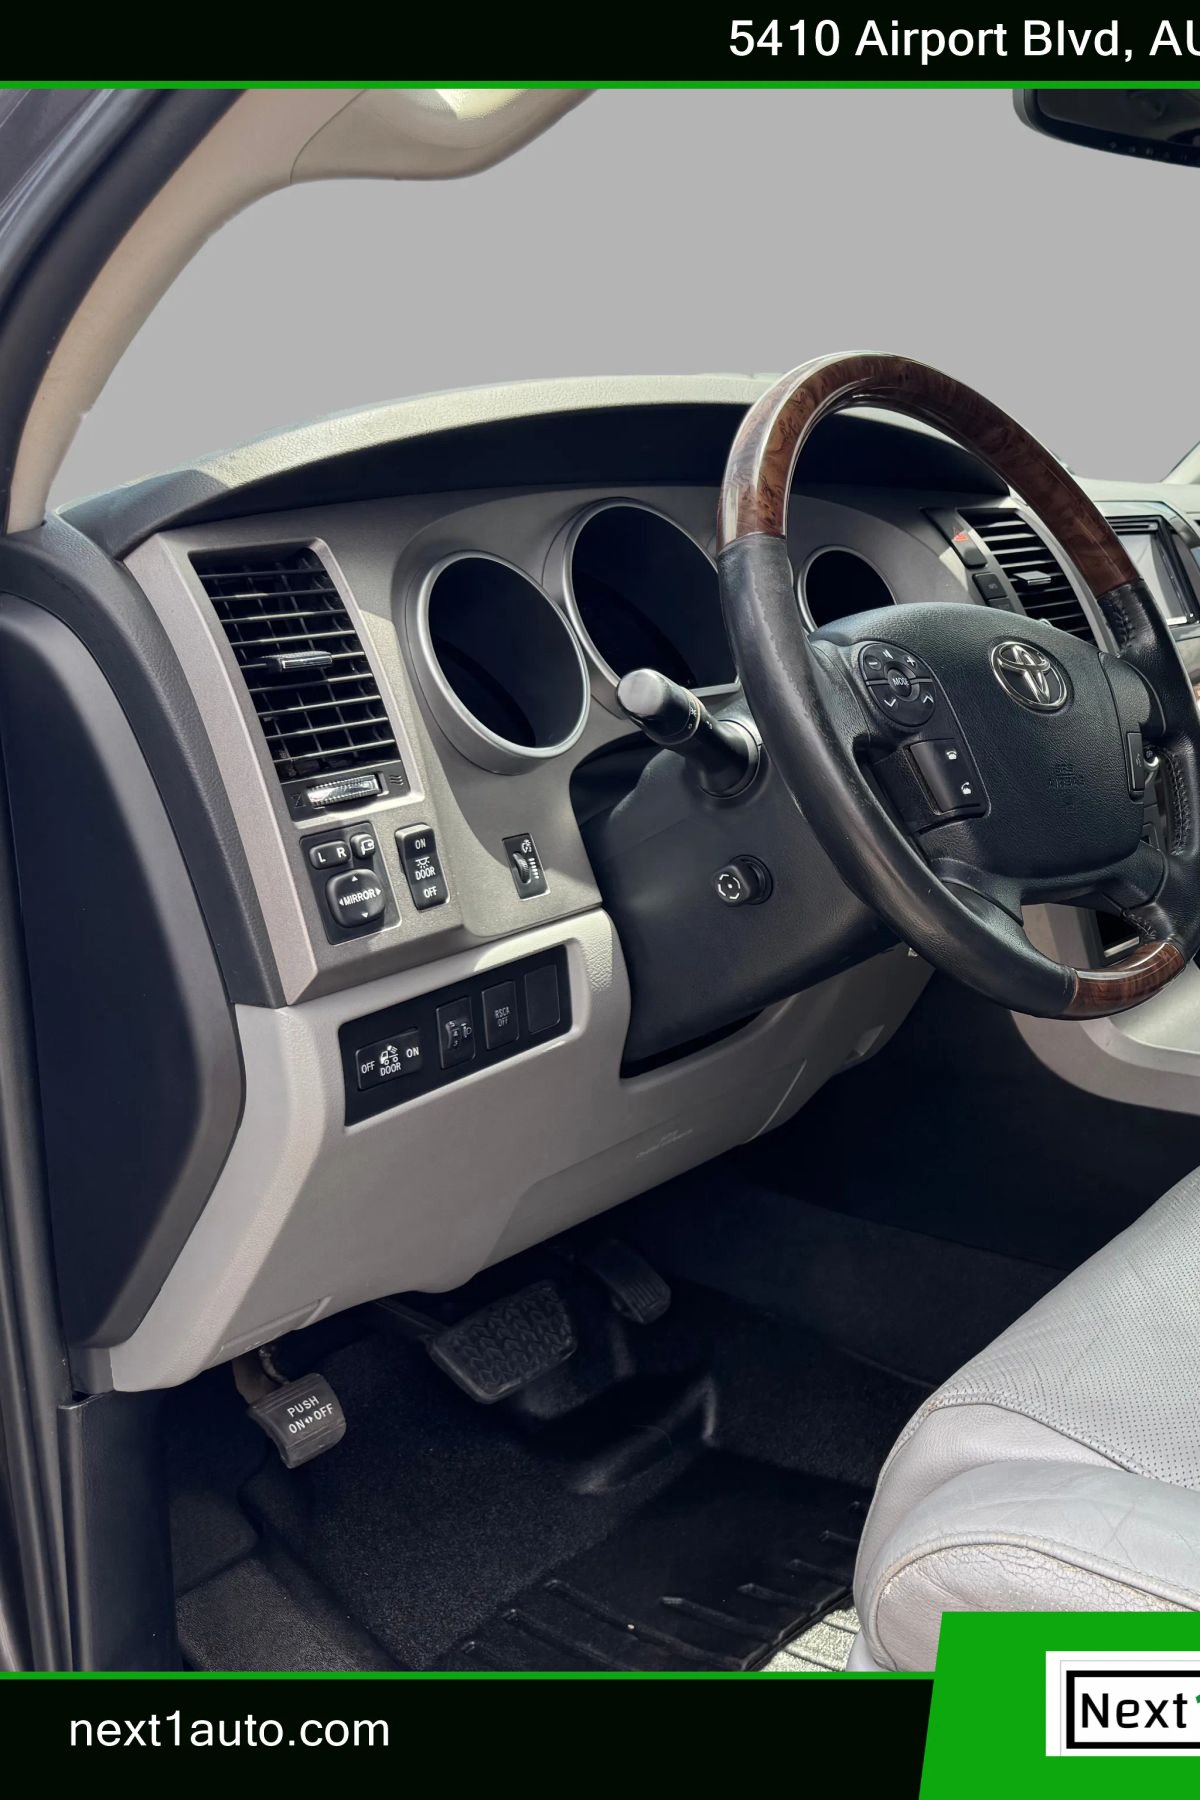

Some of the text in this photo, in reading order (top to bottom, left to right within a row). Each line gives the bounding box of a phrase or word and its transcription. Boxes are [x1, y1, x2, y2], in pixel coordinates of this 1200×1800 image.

[415, 838, 427, 850] ON
[317, 846, 347, 863] L R
[415, 866, 436, 880] DOOR
[343, 888, 376, 906] MIRROR
[423, 885, 437, 899] OFF
[497, 1015, 508, 1027] OFF
[406, 1046, 420, 1058] ON
[361, 1060, 375, 1074] OFF
[380, 1062, 401, 1077] DOOR
[287, 1395, 320, 1417] PUSH
[288, 1402, 334, 1434] ON OFF
